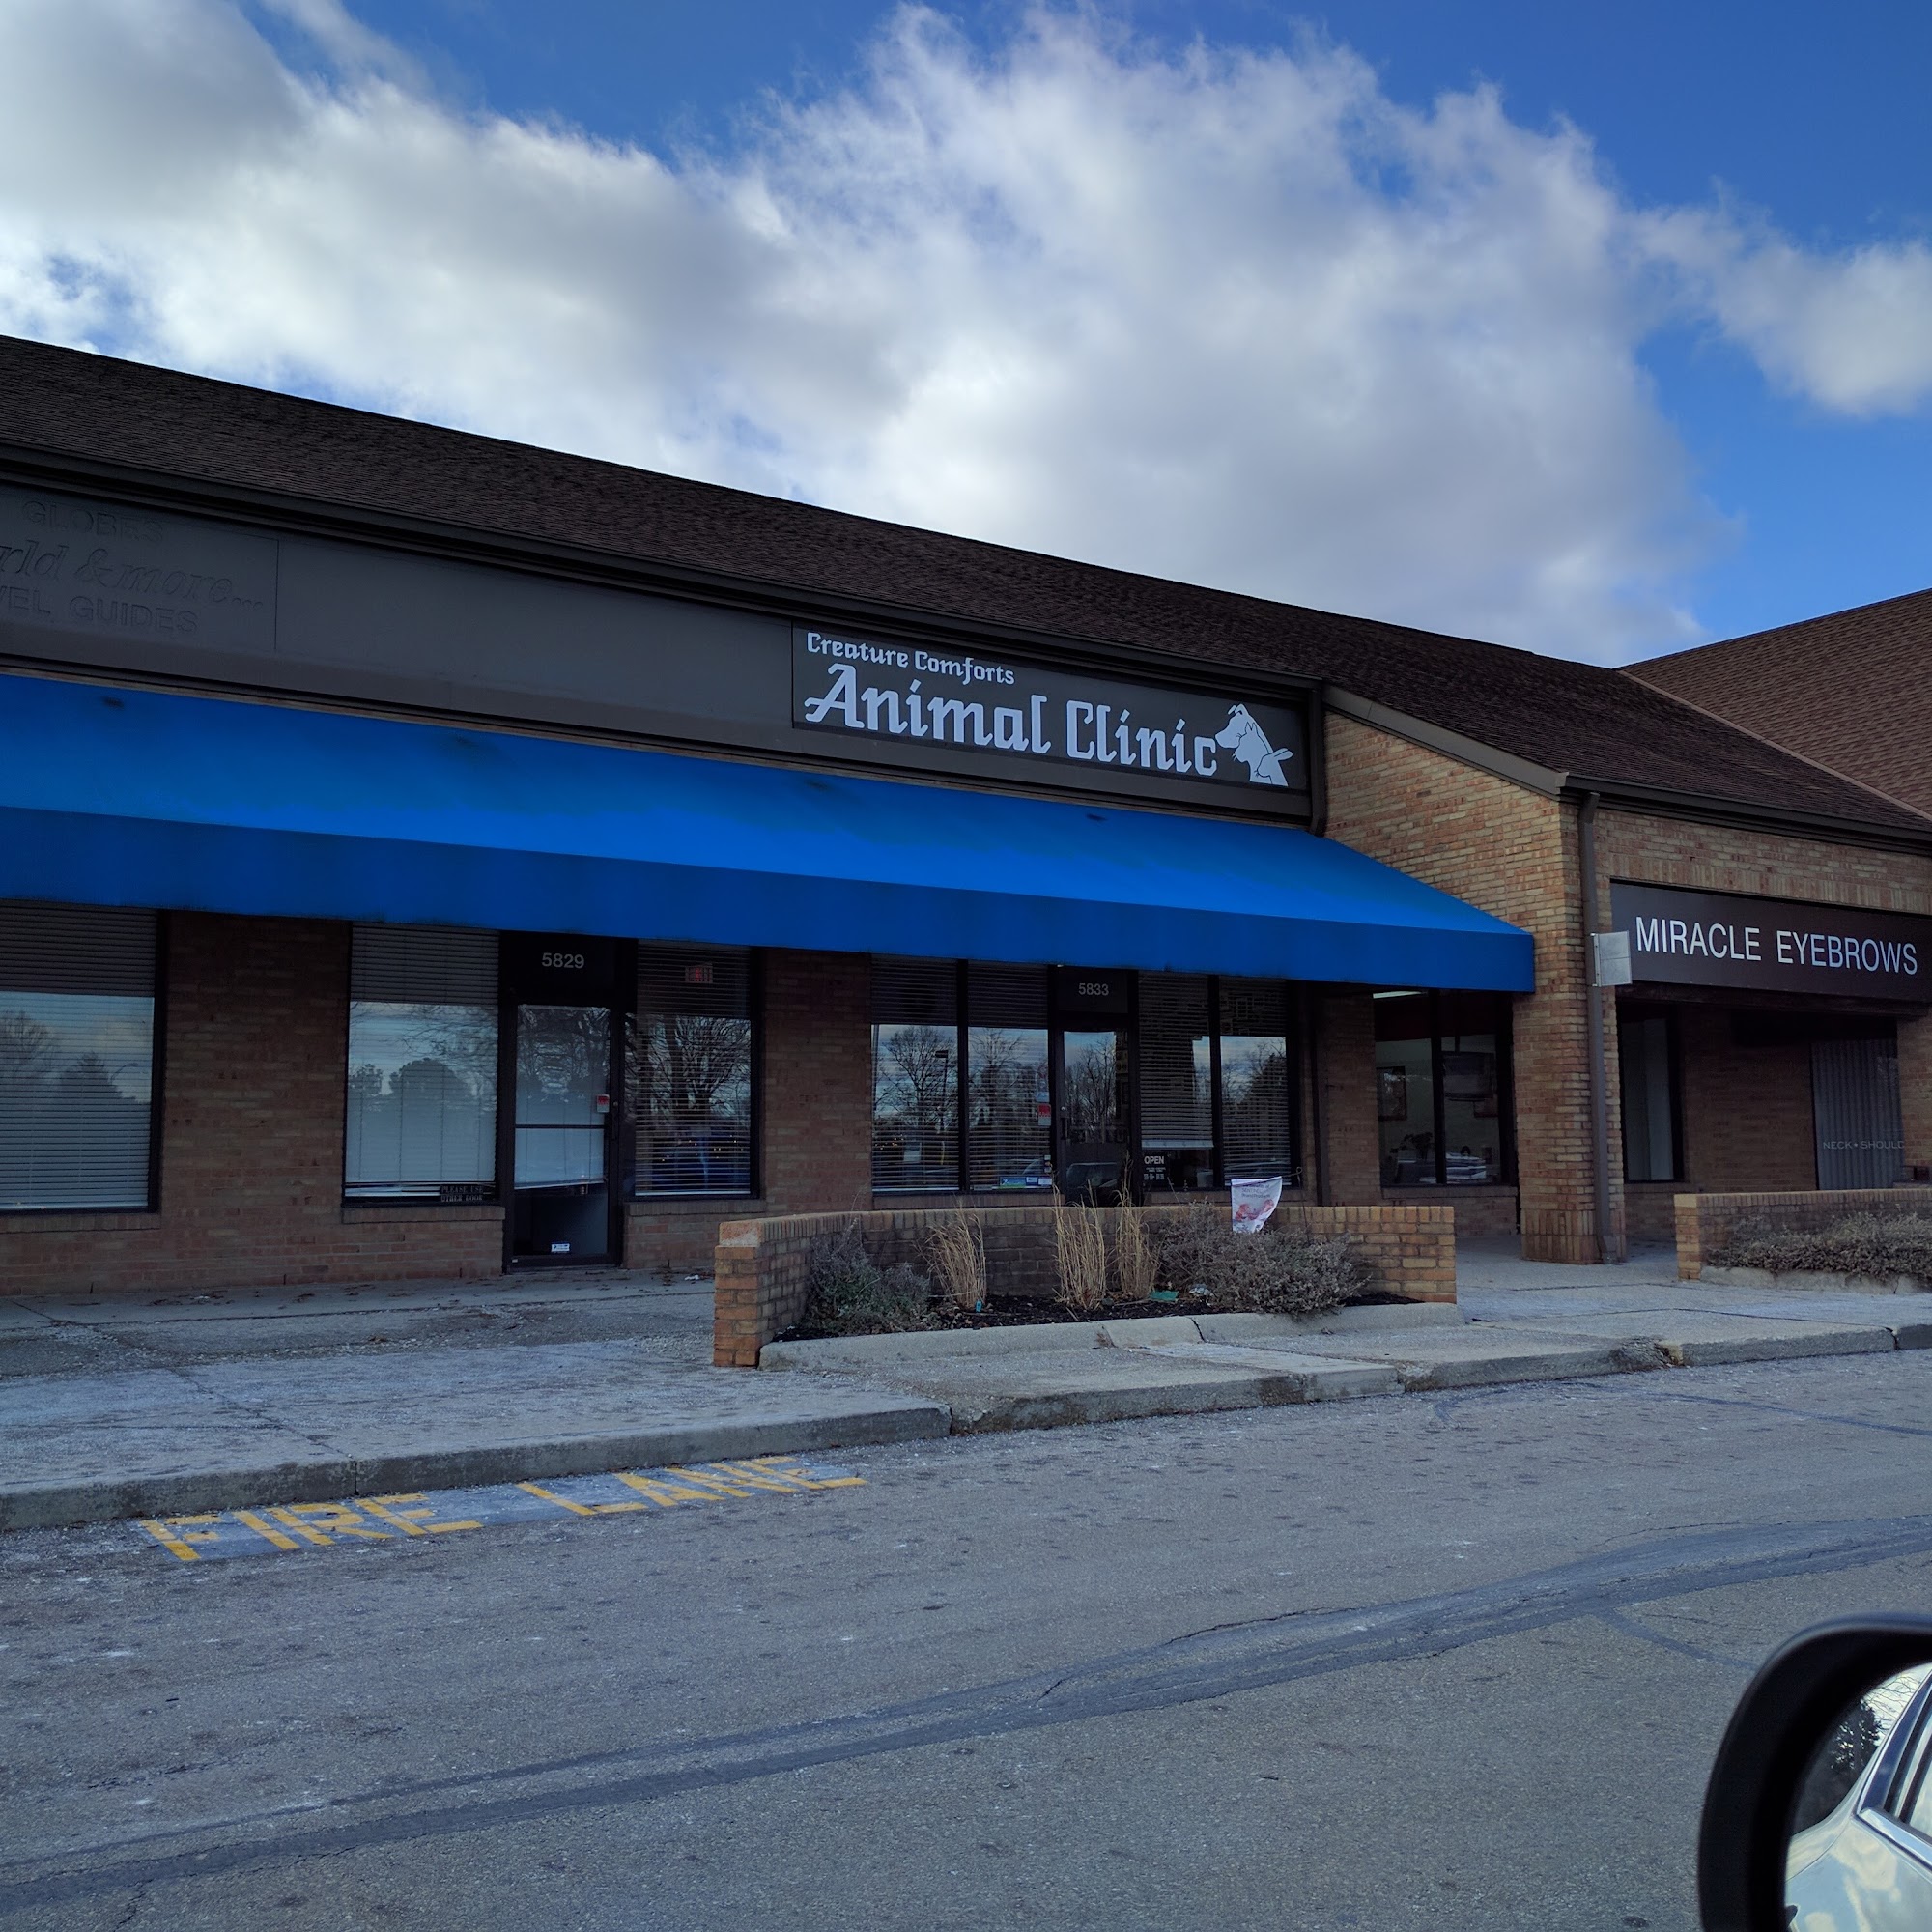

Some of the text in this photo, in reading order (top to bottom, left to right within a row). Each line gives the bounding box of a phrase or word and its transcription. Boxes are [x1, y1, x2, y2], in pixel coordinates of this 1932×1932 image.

[21, 500, 163, 543] GLOBES
[70, 595, 198, 631] GUIDES
[807, 631, 1015, 685] Creature Comforts
[804, 662, 1217, 777] Animal Clinic
[541, 952, 585, 969] 5829
[1635, 916, 1918, 976] MIRACLE EYEBROWS
[1078, 982, 1110, 997] 5833
[1144, 1155, 1165, 1165] OPEN
[1823, 1140, 1853, 1150] NECK
[440, 1185, 468, 1194] PLEASE
[139, 1455, 868, 1561] FIRE LANE
